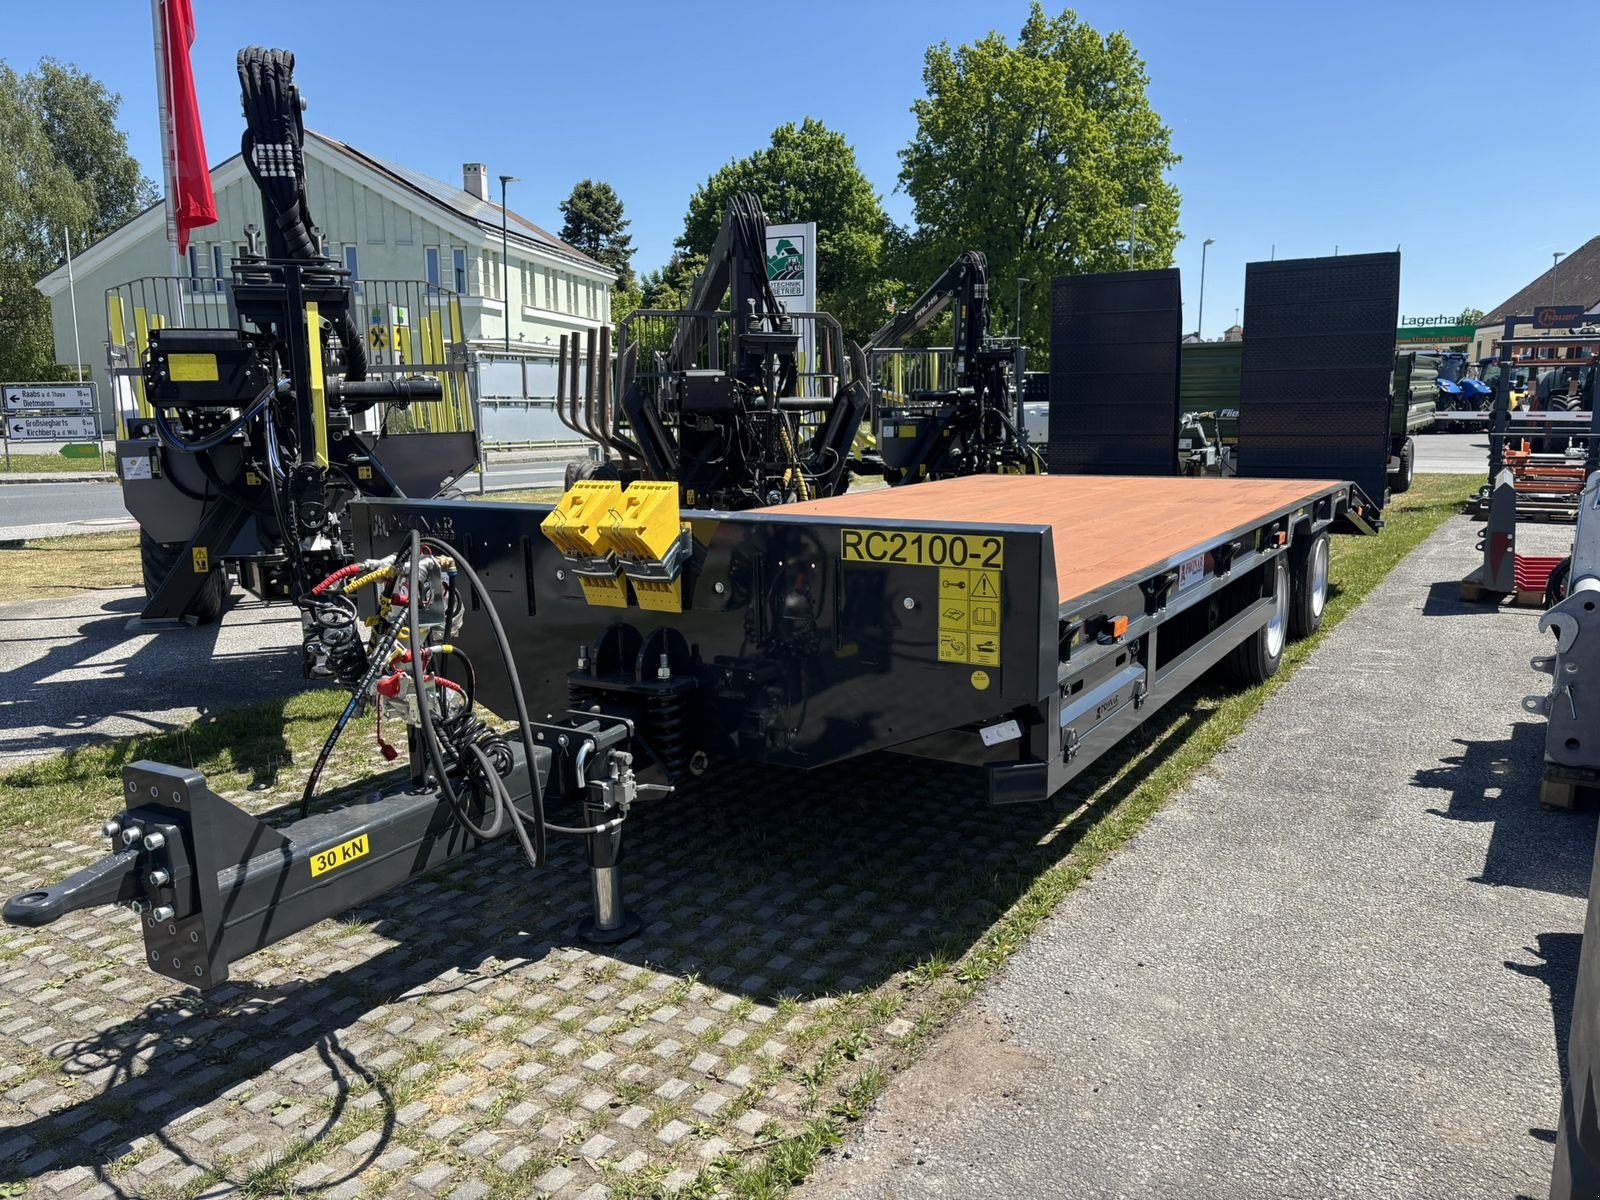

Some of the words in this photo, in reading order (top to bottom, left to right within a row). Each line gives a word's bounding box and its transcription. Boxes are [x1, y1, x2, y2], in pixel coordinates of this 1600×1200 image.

[22, 390, 41, 398] Raabs
[23, 399, 55, 407] Dietmanns
[26, 428, 57, 438] Kirchberg
[842, 529, 1002, 569] RC2100-2
[316, 850, 337, 871] 30
[341, 838, 364, 861] kN
